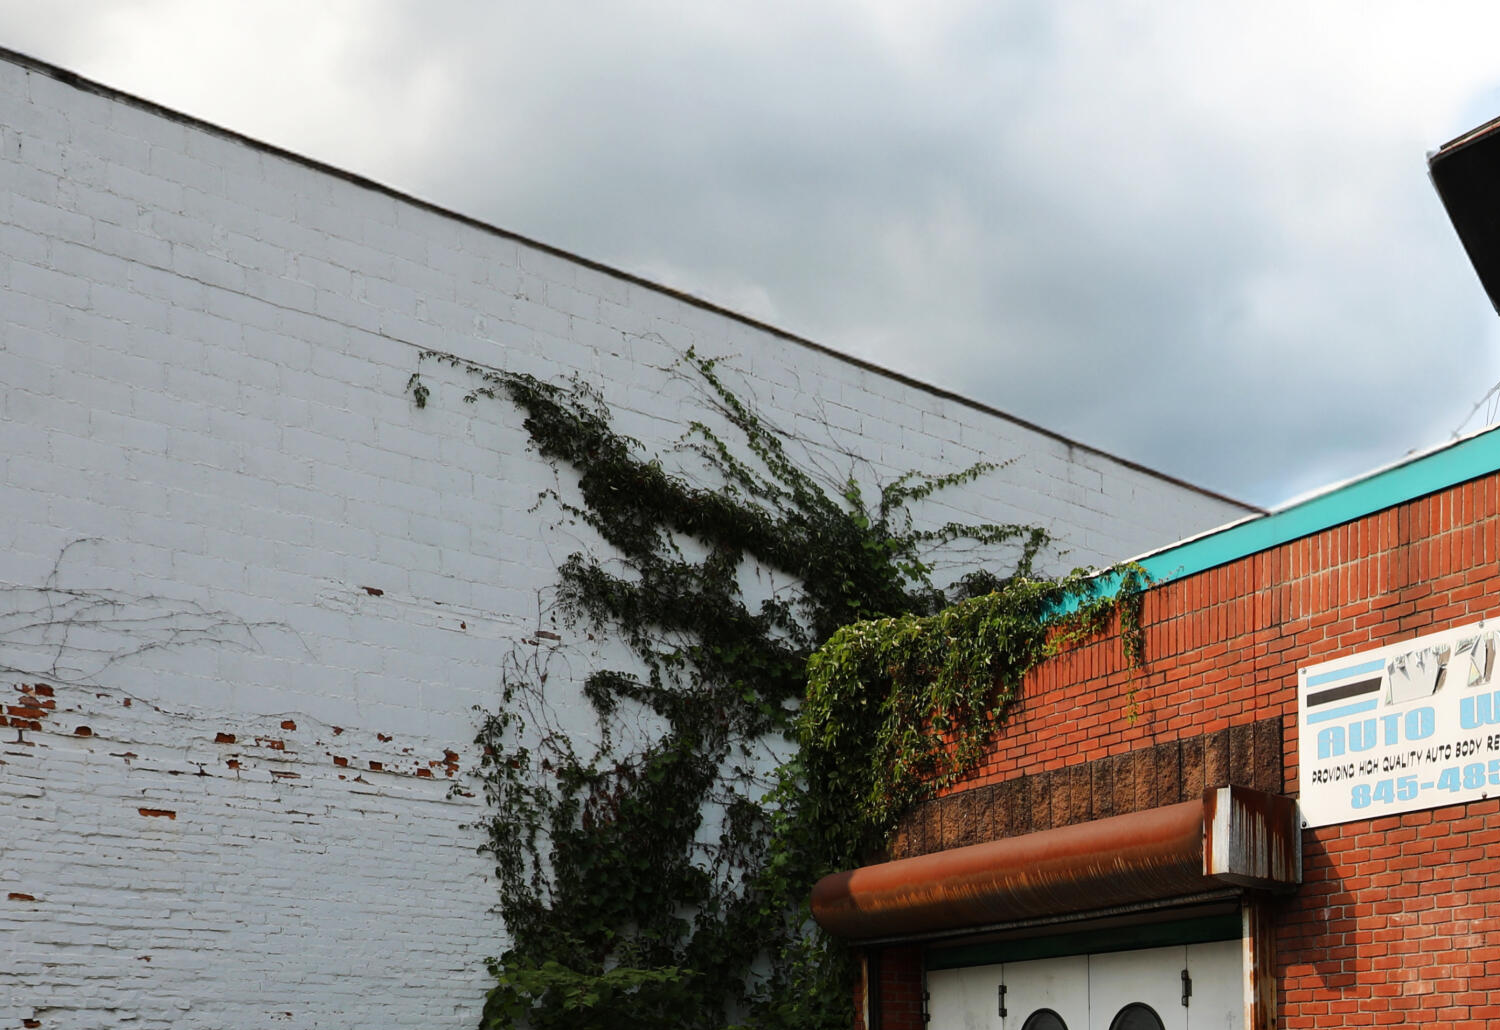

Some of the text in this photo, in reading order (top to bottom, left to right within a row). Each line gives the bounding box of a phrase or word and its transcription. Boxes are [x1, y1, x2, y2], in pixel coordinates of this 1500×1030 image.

[1317, 706, 1436, 760] AUTO
[1312, 762, 1355, 785] PROVIDING
[1358, 757, 1378, 775] HIGH
[1382, 750, 1423, 772] QUALITY
[1426, 744, 1452, 763] AUTO
[1455, 737, 1483, 758] BODY
